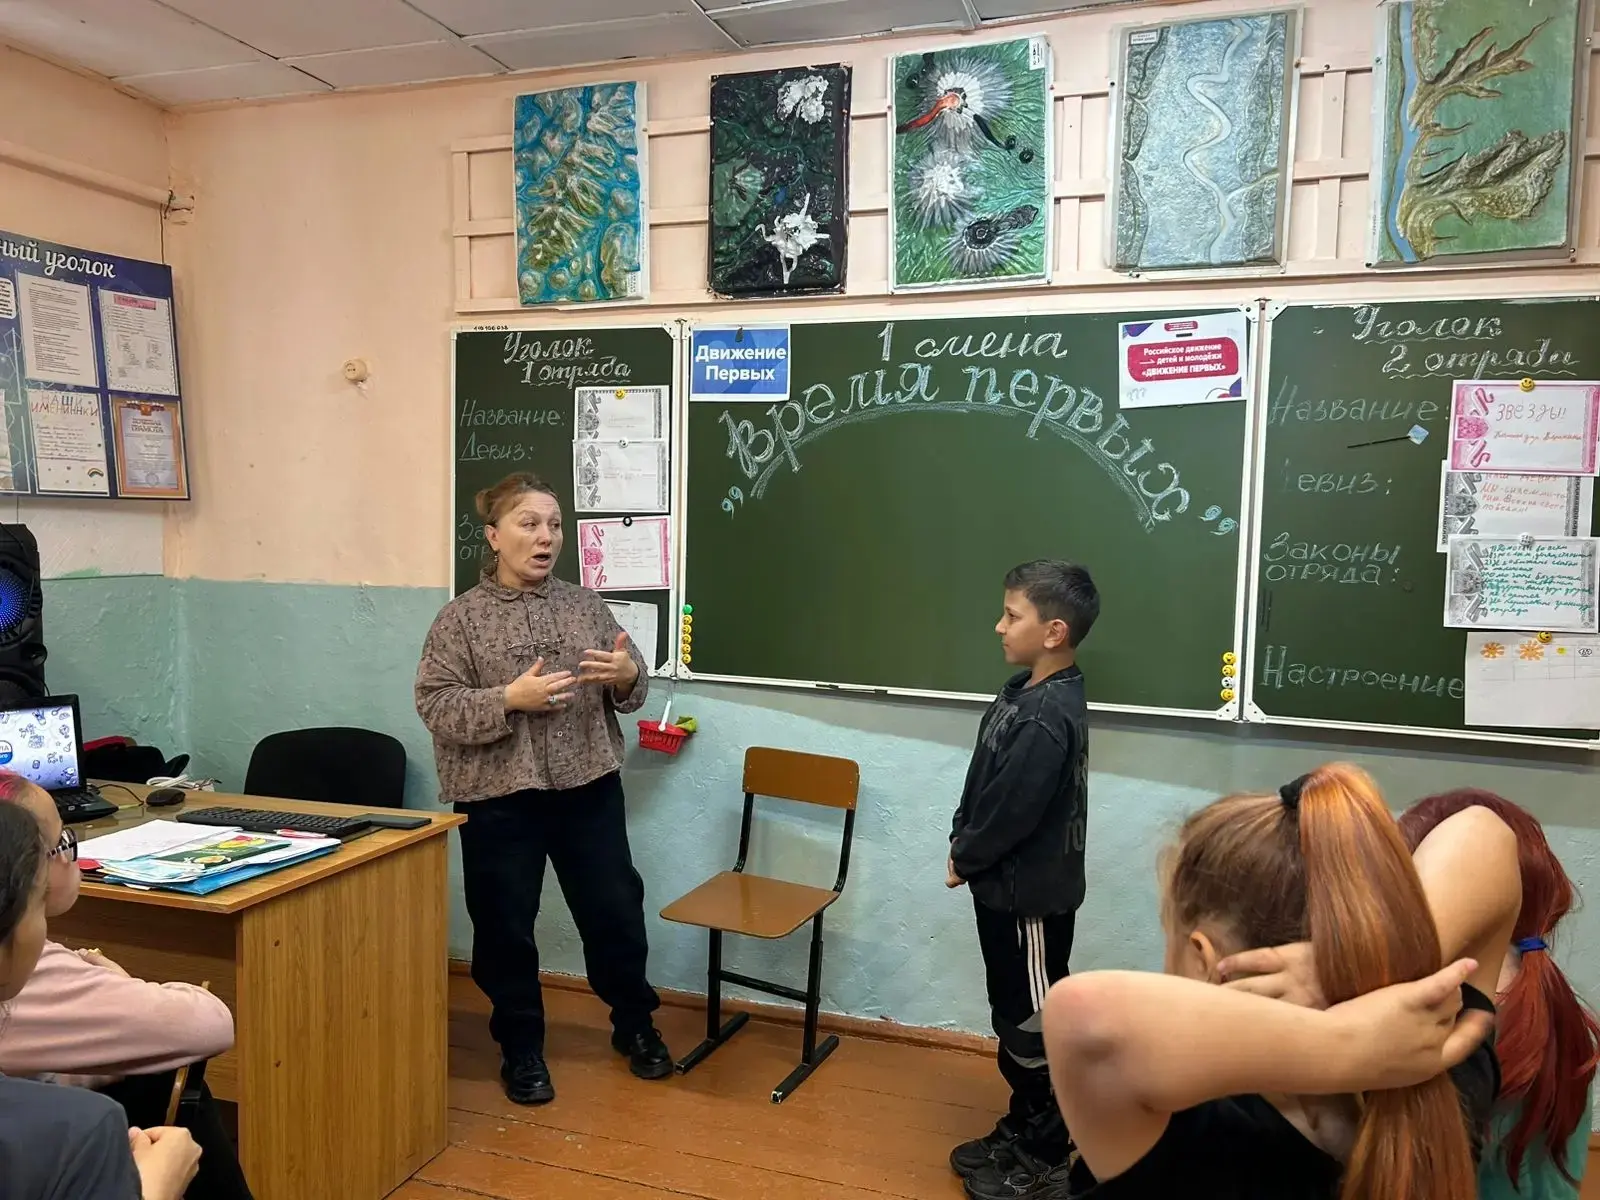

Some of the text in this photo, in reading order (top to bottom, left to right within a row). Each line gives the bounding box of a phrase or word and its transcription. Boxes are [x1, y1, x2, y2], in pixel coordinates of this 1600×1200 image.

[44, 249, 116, 278] уголок
[1352, 305, 1502, 340] Уголок
[503, 331, 596, 364] Уголок
[694, 344, 788, 362] Движение
[878, 322, 1068, 362] 1 смена
[1143, 343, 1222, 356] Российское движение
[520, 355, 632, 390] 1 отряда
[705, 365, 776, 384] Первых
[1157, 355, 1178, 365] детей
[1382, 338, 1581, 380] 2 отряда
[460, 398, 566, 426] Название:
[1267, 376, 1450, 427] Название:
[459, 431, 534, 461] Девиз:
[1282, 460, 1393, 496] евиз:
[1263, 531, 1401, 565] Законы
[1265, 563, 1401, 586] отряда:
[1259, 645, 1464, 699] Настроение
